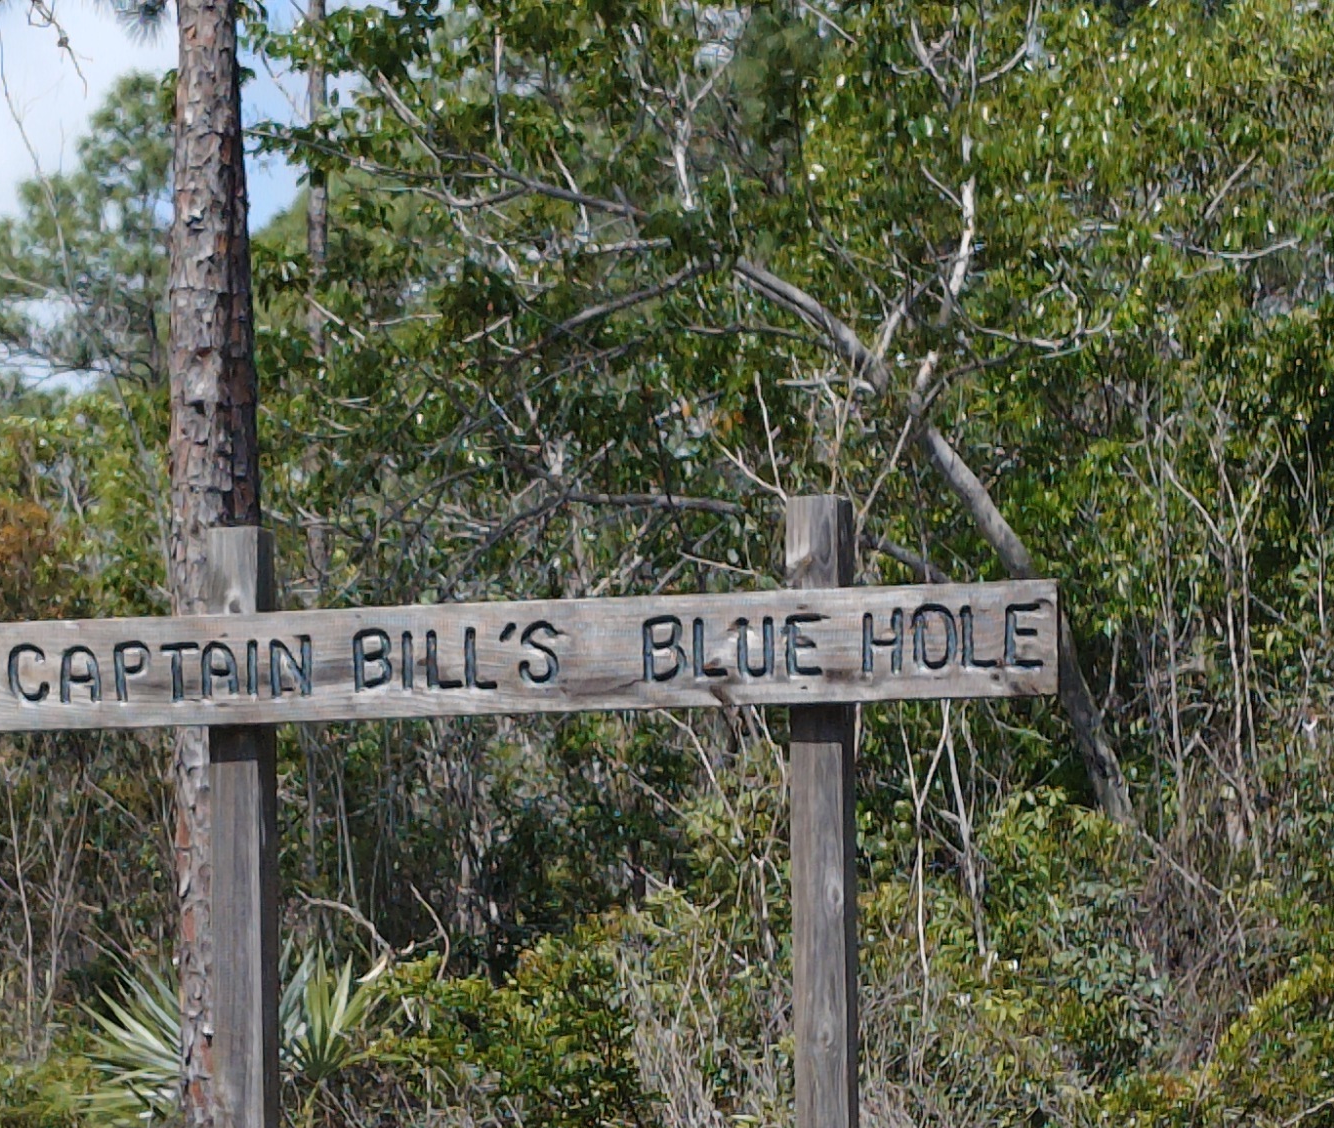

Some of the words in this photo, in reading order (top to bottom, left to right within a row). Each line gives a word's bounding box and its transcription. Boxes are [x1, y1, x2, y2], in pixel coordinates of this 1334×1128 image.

[7, 634, 313, 703] CAPTAIN
[353, 620, 561, 693] BILL'S
[642, 613, 828, 683] BLUE
[863, 602, 1046, 675] HOLE
